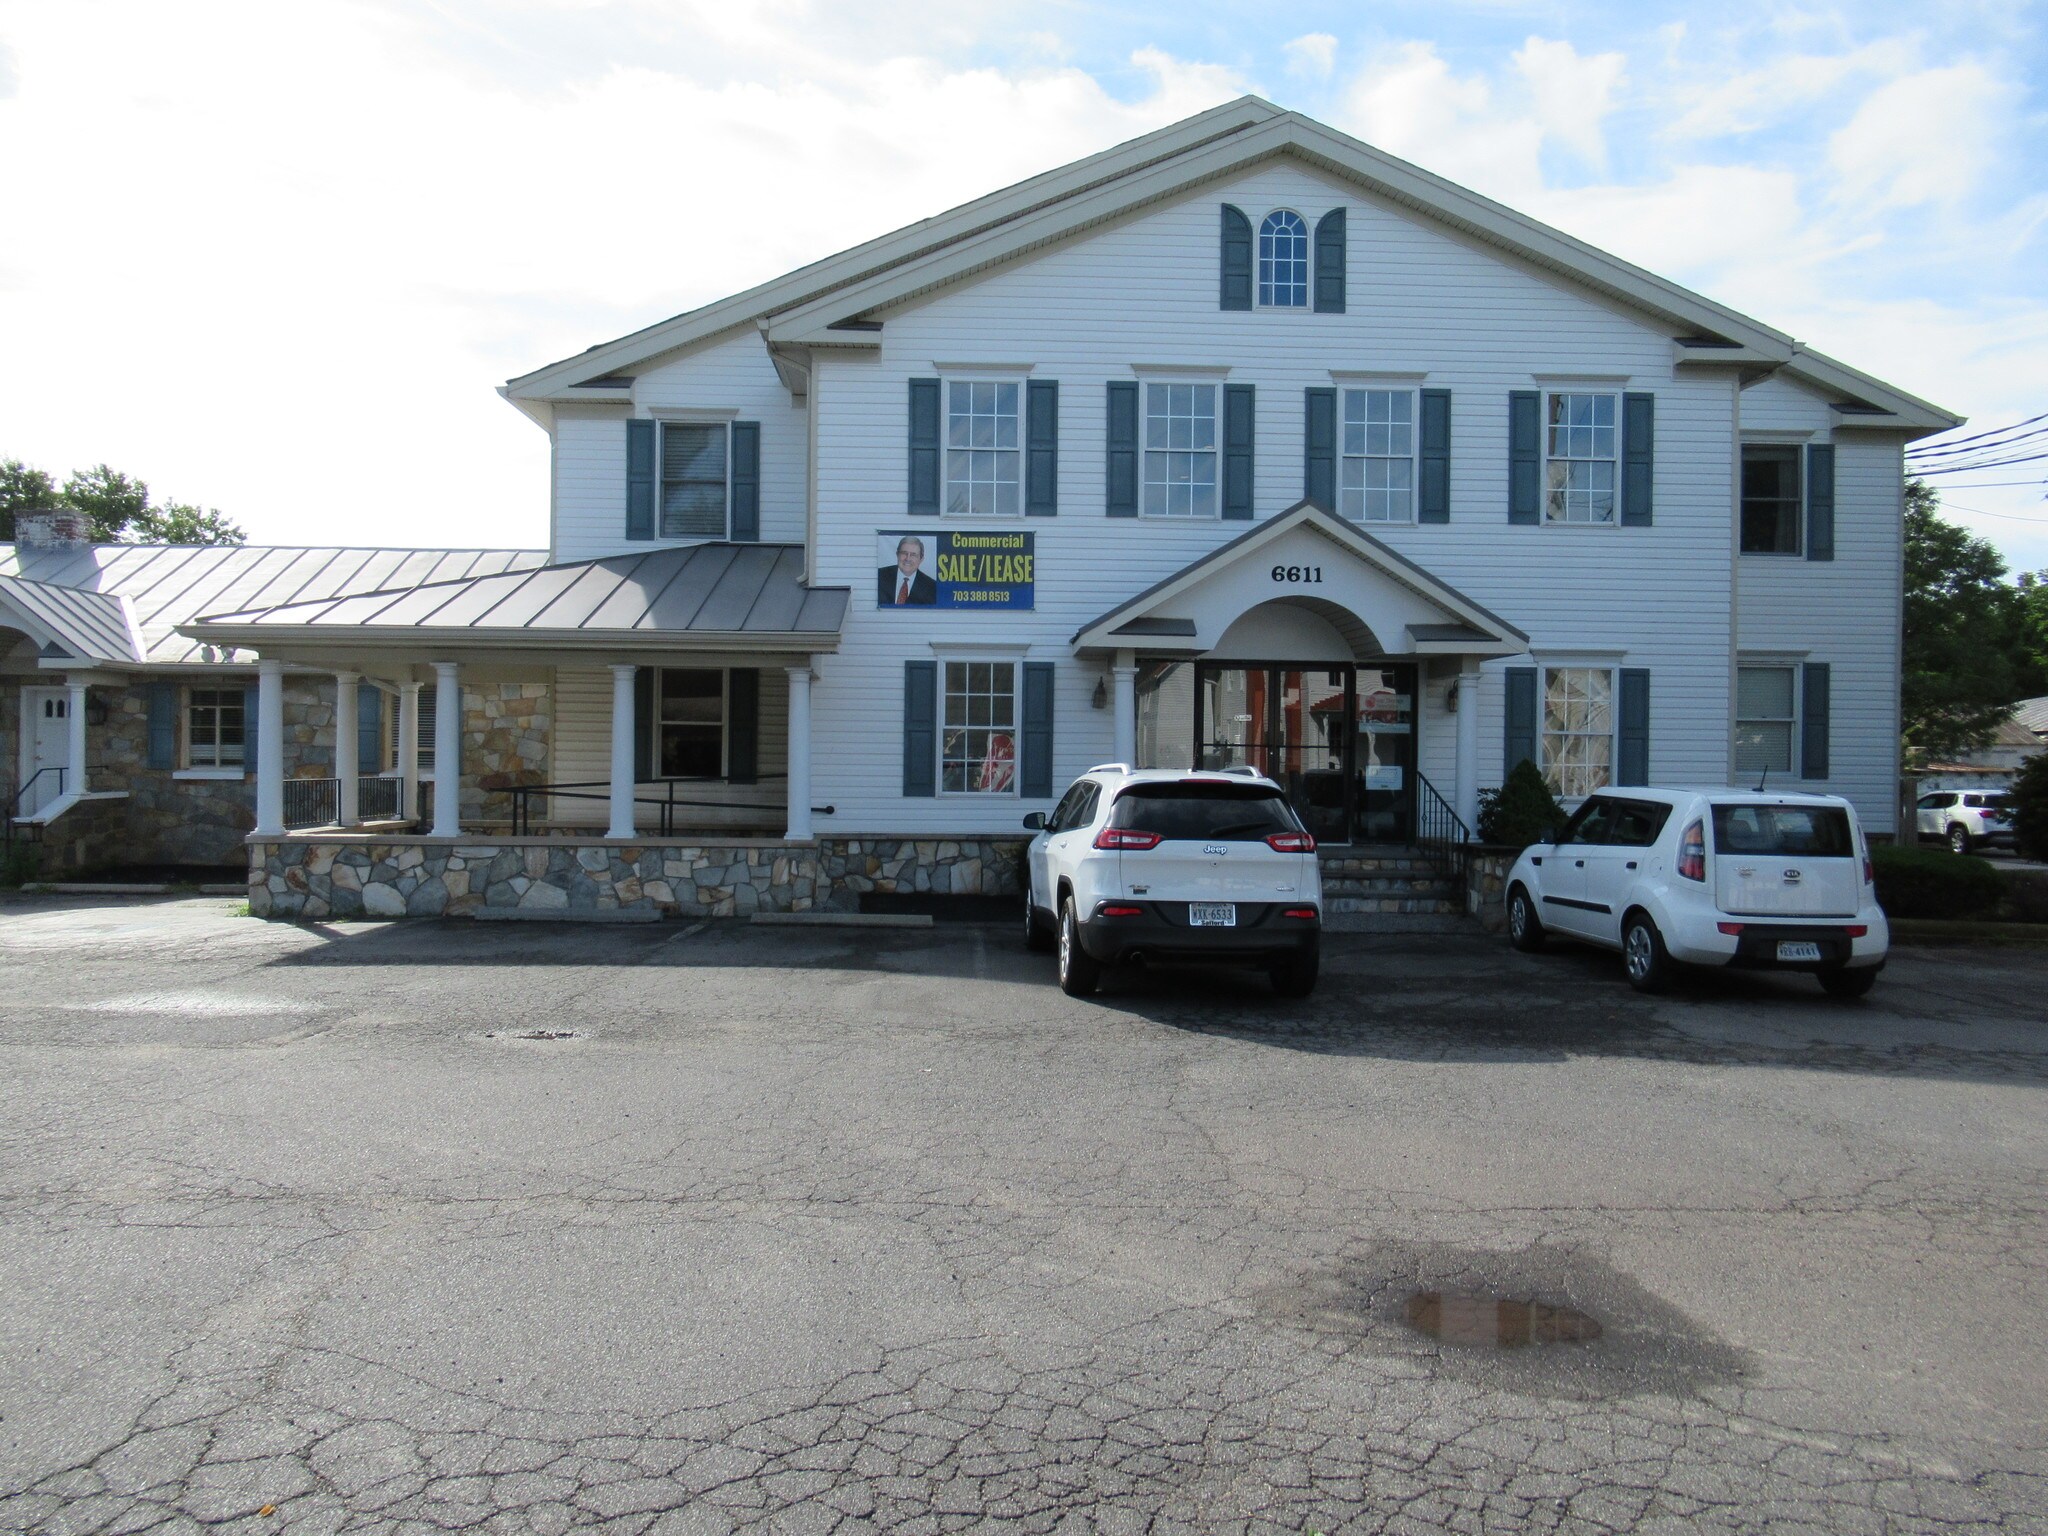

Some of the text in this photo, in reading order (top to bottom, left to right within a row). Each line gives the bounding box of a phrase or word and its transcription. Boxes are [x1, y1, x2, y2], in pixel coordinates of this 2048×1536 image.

[952, 533, 1024, 548] Commercial
[938, 554, 1033, 583] SALE/LEASE
[1271, 566, 1323, 583] 6611
[953, 591, 1010, 602] 703 388 8513
[1203, 845, 1228, 855] Jeep
